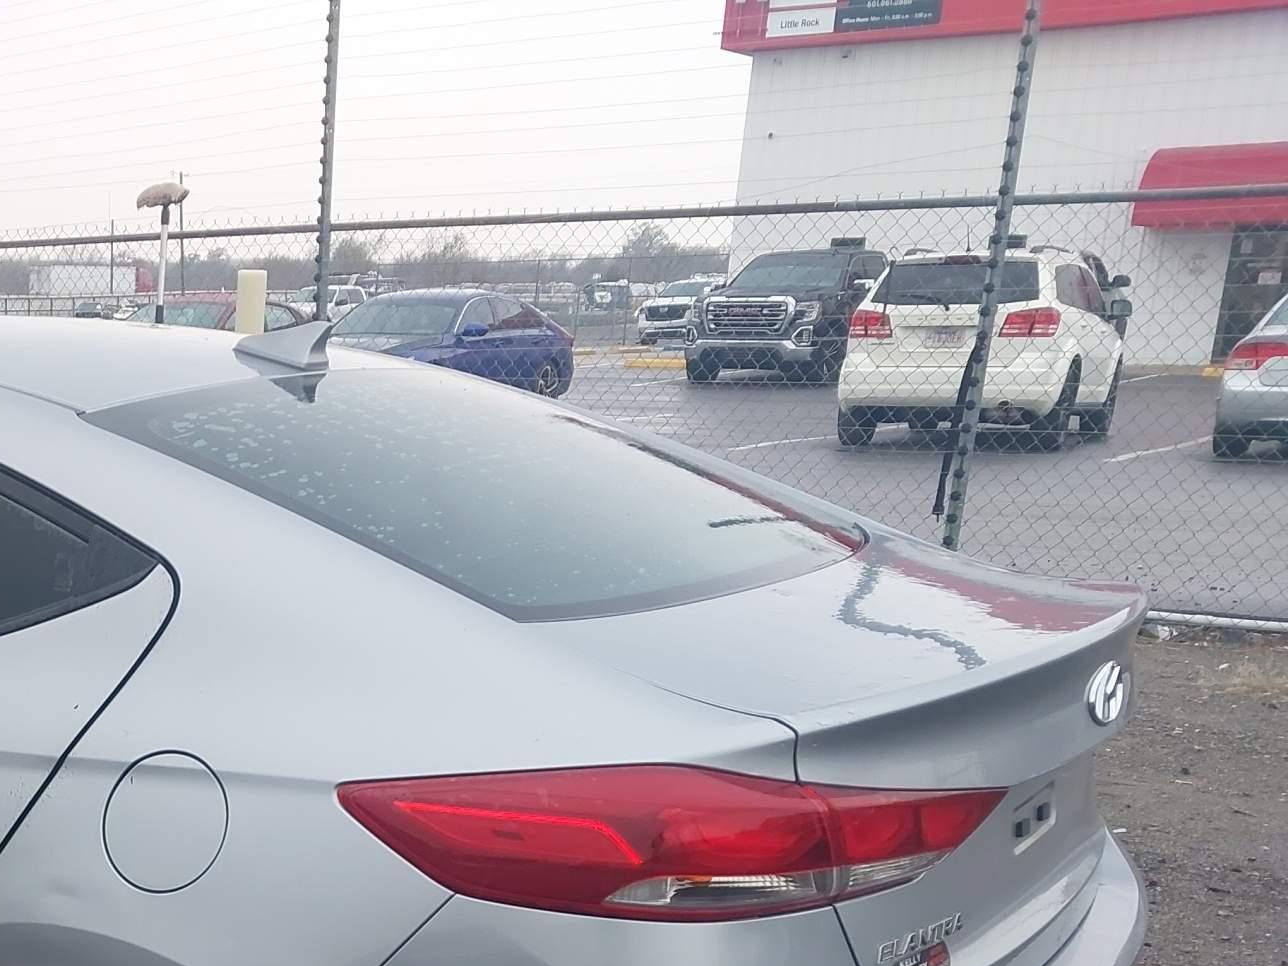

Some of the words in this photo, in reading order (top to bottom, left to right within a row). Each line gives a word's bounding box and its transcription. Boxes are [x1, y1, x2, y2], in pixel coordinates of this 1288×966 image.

[780, 20, 799, 29] Little
[801, 18, 819, 27] Rock
[878, 912, 962, 964] ELANTRA
